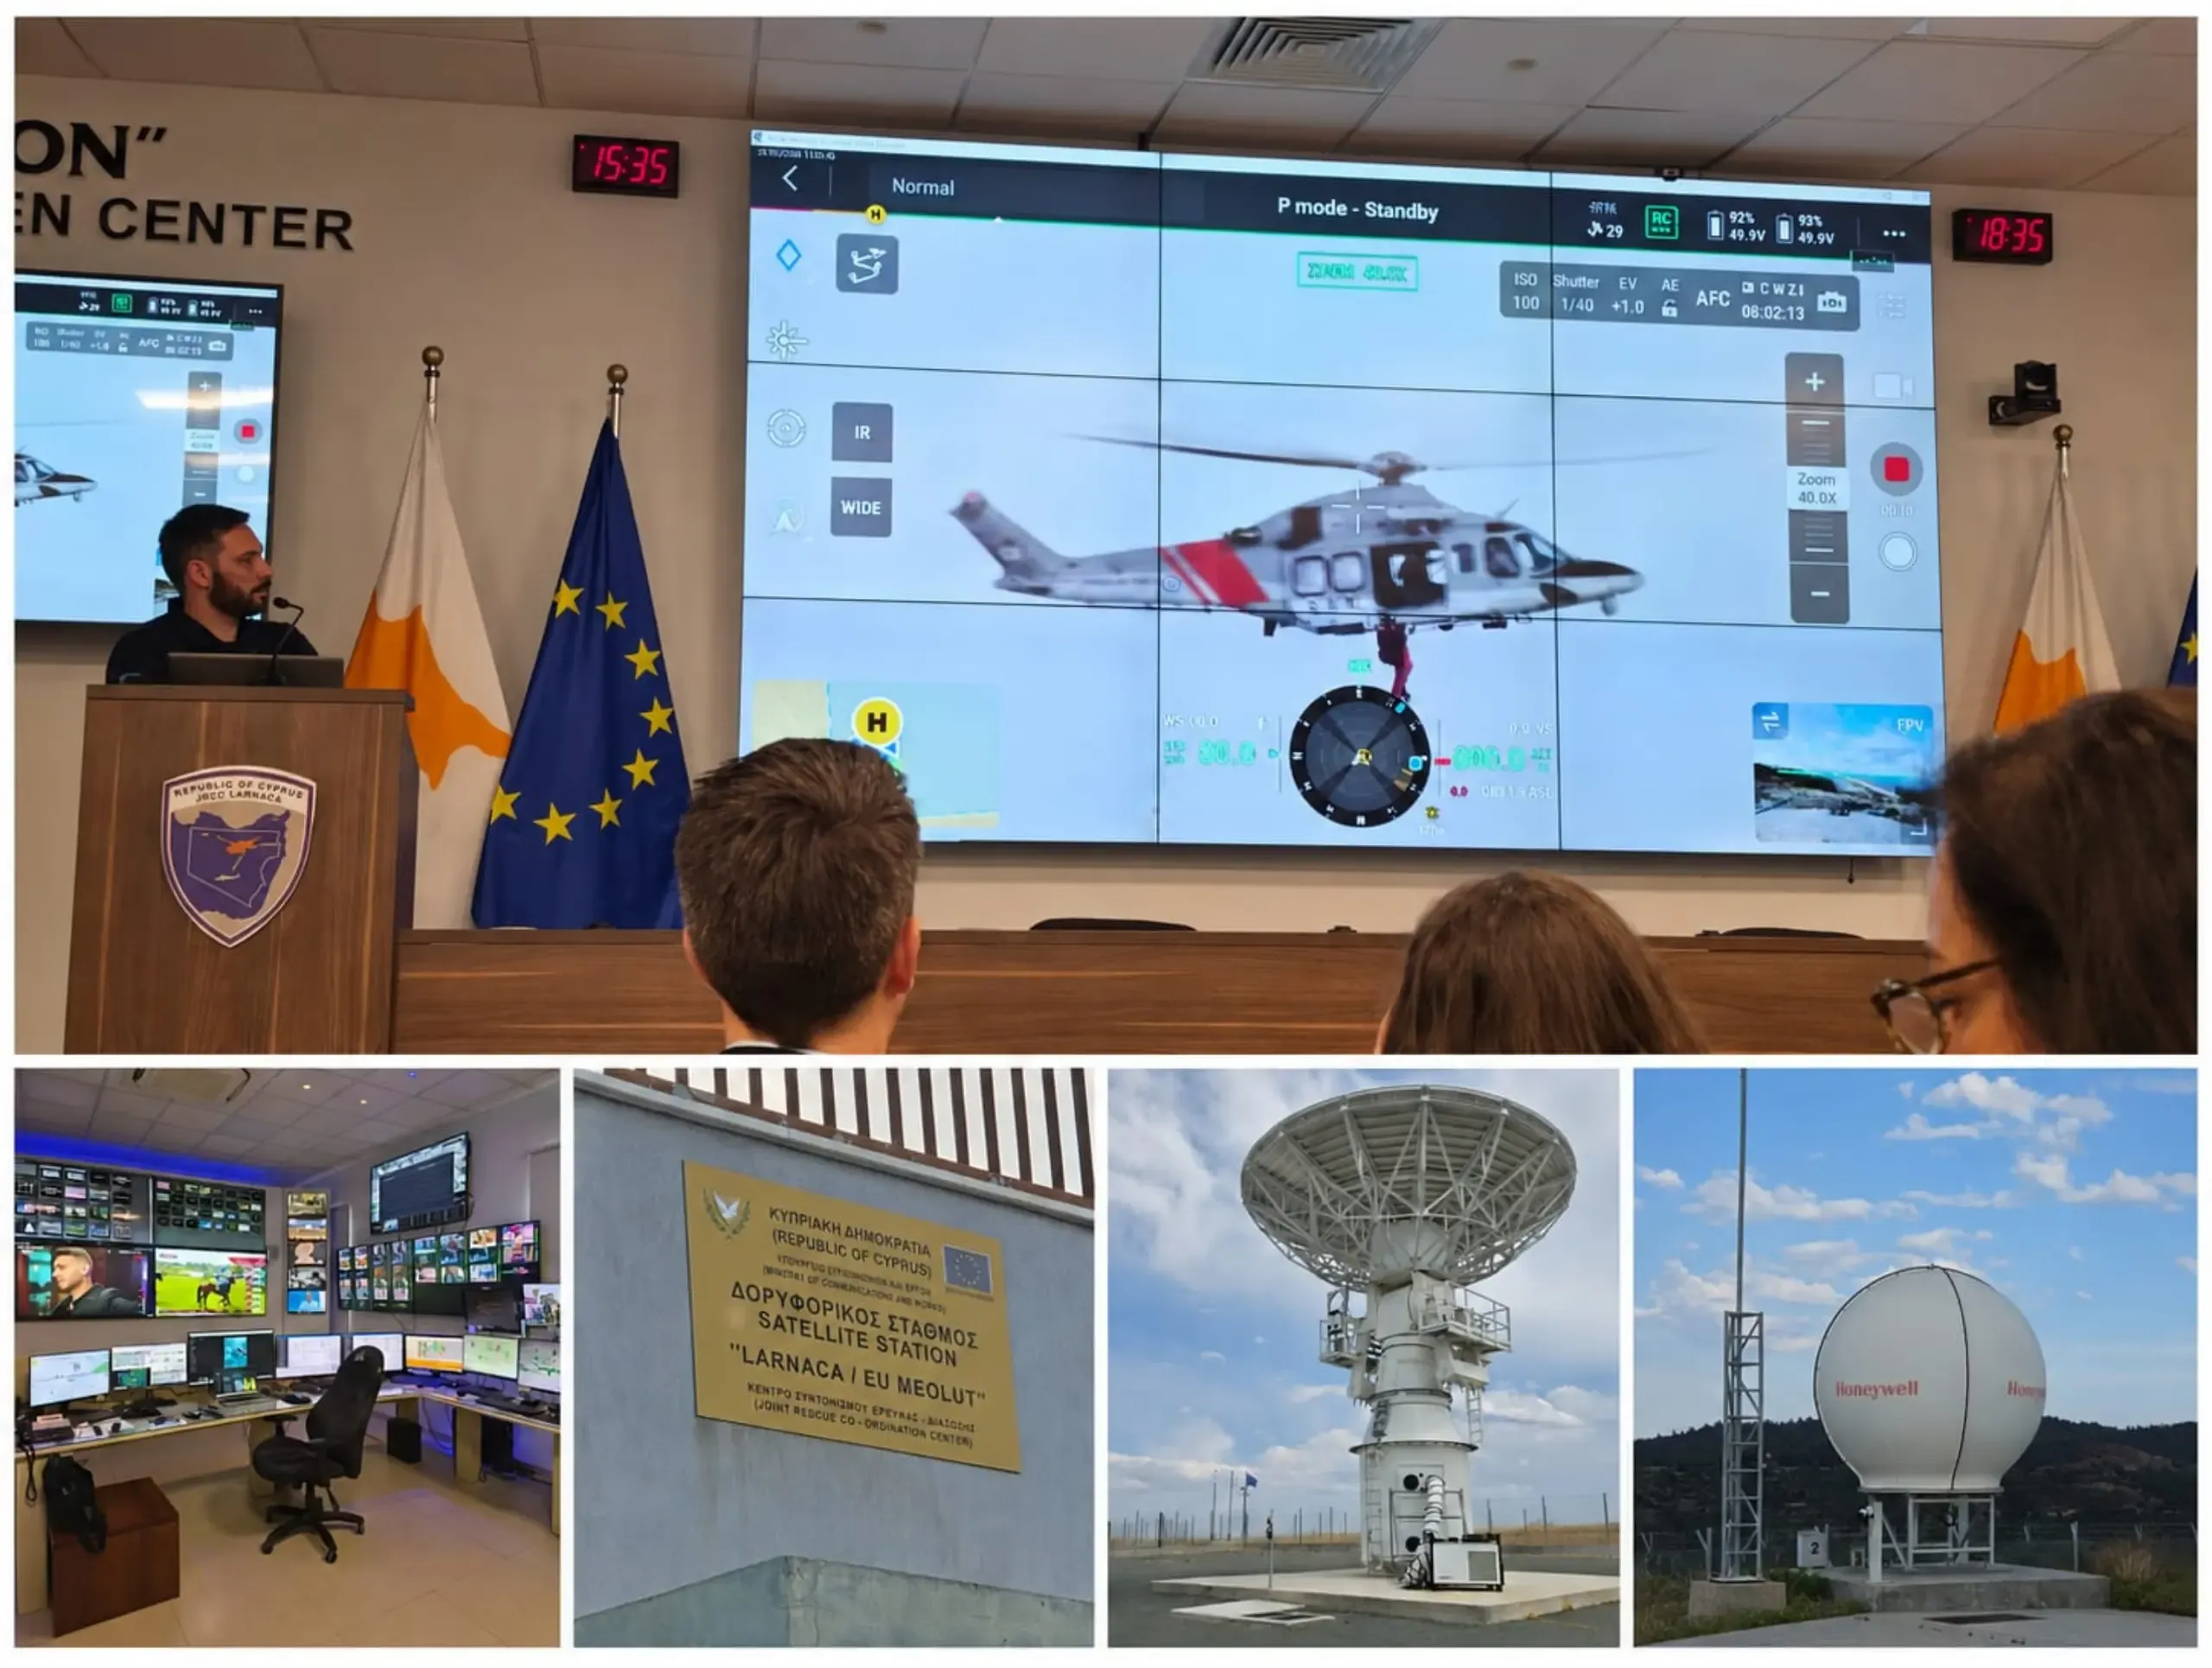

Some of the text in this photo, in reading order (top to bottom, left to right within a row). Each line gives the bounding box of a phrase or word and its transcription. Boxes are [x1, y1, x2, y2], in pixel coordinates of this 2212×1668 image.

[594, 144, 668, 183] 15:35
[892, 177, 955, 196] Normal
[870, 209, 881, 220] H
[1278, 197, 1291, 213] P
[1295, 199, 1348, 216] mode
[1365, 201, 1440, 224] Standby
[1651, 211, 1673, 225] RC
[1729, 211, 1755, 224] 92%
[15, 191, 354, 251] N CENTER
[1798, 214, 1823, 227] 93%
[1606, 224, 1624, 239] 29
[1729, 228, 1766, 242] 49.9V
[1798, 232, 1835, 245] 49.9V
[1980, 217, 2044, 252] 18:35
[1514, 272, 1538, 286] ISO
[1553, 274, 1600, 289] Shutter
[1619, 277, 1637, 290] EV
[1662, 278, 1681, 292] AE
[1513, 296, 1540, 309] 100
[1561, 297, 1594, 312] 1/40
[1696, 290, 1732, 307] AFC
[1611, 300, 1645, 315] +1.0
[1742, 304, 1805, 321] 08:02:13
[855, 425, 871, 440] IR
[1797, 473, 1836, 487] Zoom
[1798, 491, 1838, 506] 40.0X
[840, 500, 881, 516] WIDE
[867, 712, 887, 733] H
[1163, 714, 1185, 727] WS
[1897, 718, 1924, 732] FPV
[174, 780, 233, 797] REPUBLIC
[258, 781, 304, 799] CYPRUS
[229, 790, 283, 803] LARNACA
[769, 1206, 931, 1258] ΚΥΠΡΙΑΚΗ ΔΗΜΟΚΡΑΤΙΑ
[772, 1228, 847, 1257] (REPUBLIC
[851, 1247, 869, 1262] OF
[874, 1252, 932, 1281] CYPRUS)
[731, 1281, 979, 1350] ΔΟΡΥΦΟΡΙΚΟΣ ΣΤΑΘΜΟΣ
[758, 1310, 957, 1367] SATELLITE STATION
[864, 1368, 890, 1391] EU
[1835, 1379, 1919, 1400] Honeywell
[753, 1398, 790, 1415] (JOINT
[793, 1405, 836, 1423] RESCUE
[840, 1414, 855, 1425] CO
[864, 1417, 927, 1438] ORDINATION
[930, 1430, 974, 1449] CENTER)
[1809, 1541, 1820, 1555] 2
